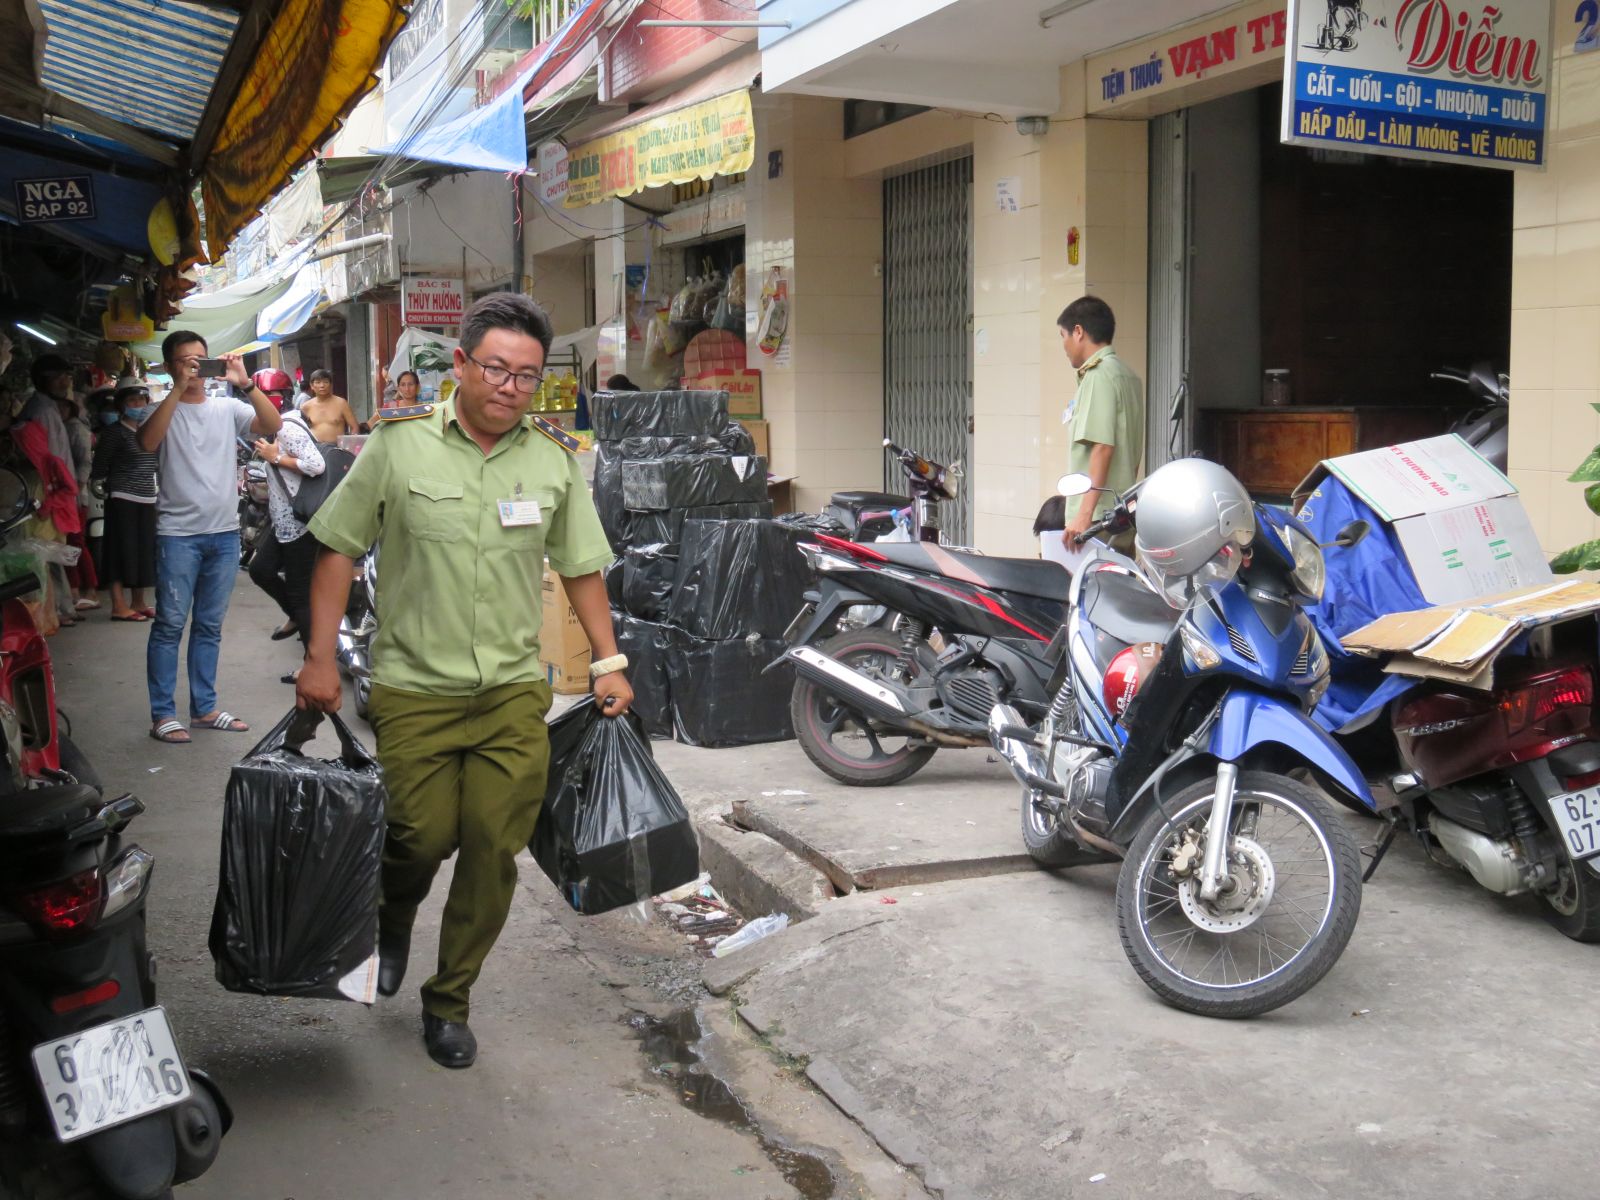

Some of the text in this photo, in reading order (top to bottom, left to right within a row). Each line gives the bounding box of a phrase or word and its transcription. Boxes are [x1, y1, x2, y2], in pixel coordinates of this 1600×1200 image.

[1102, 68, 1125, 103] TIỆM
[1130, 52, 1163, 92] THUỐC
[1168, 26, 1237, 79] VẠN
[1395, 0, 1541, 81] Diễm
[1307, 66, 1536, 123] CẮT UỐN GỘI NHUỘM DUỖI
[1301, 107, 1536, 161] HẤP DẦU LÀM MÓNG VẼ MÓNG
[24, 180, 84, 202] NGA
[25, 201, 89, 219] SẠP 92
[417, 280, 438, 288] BÁC
